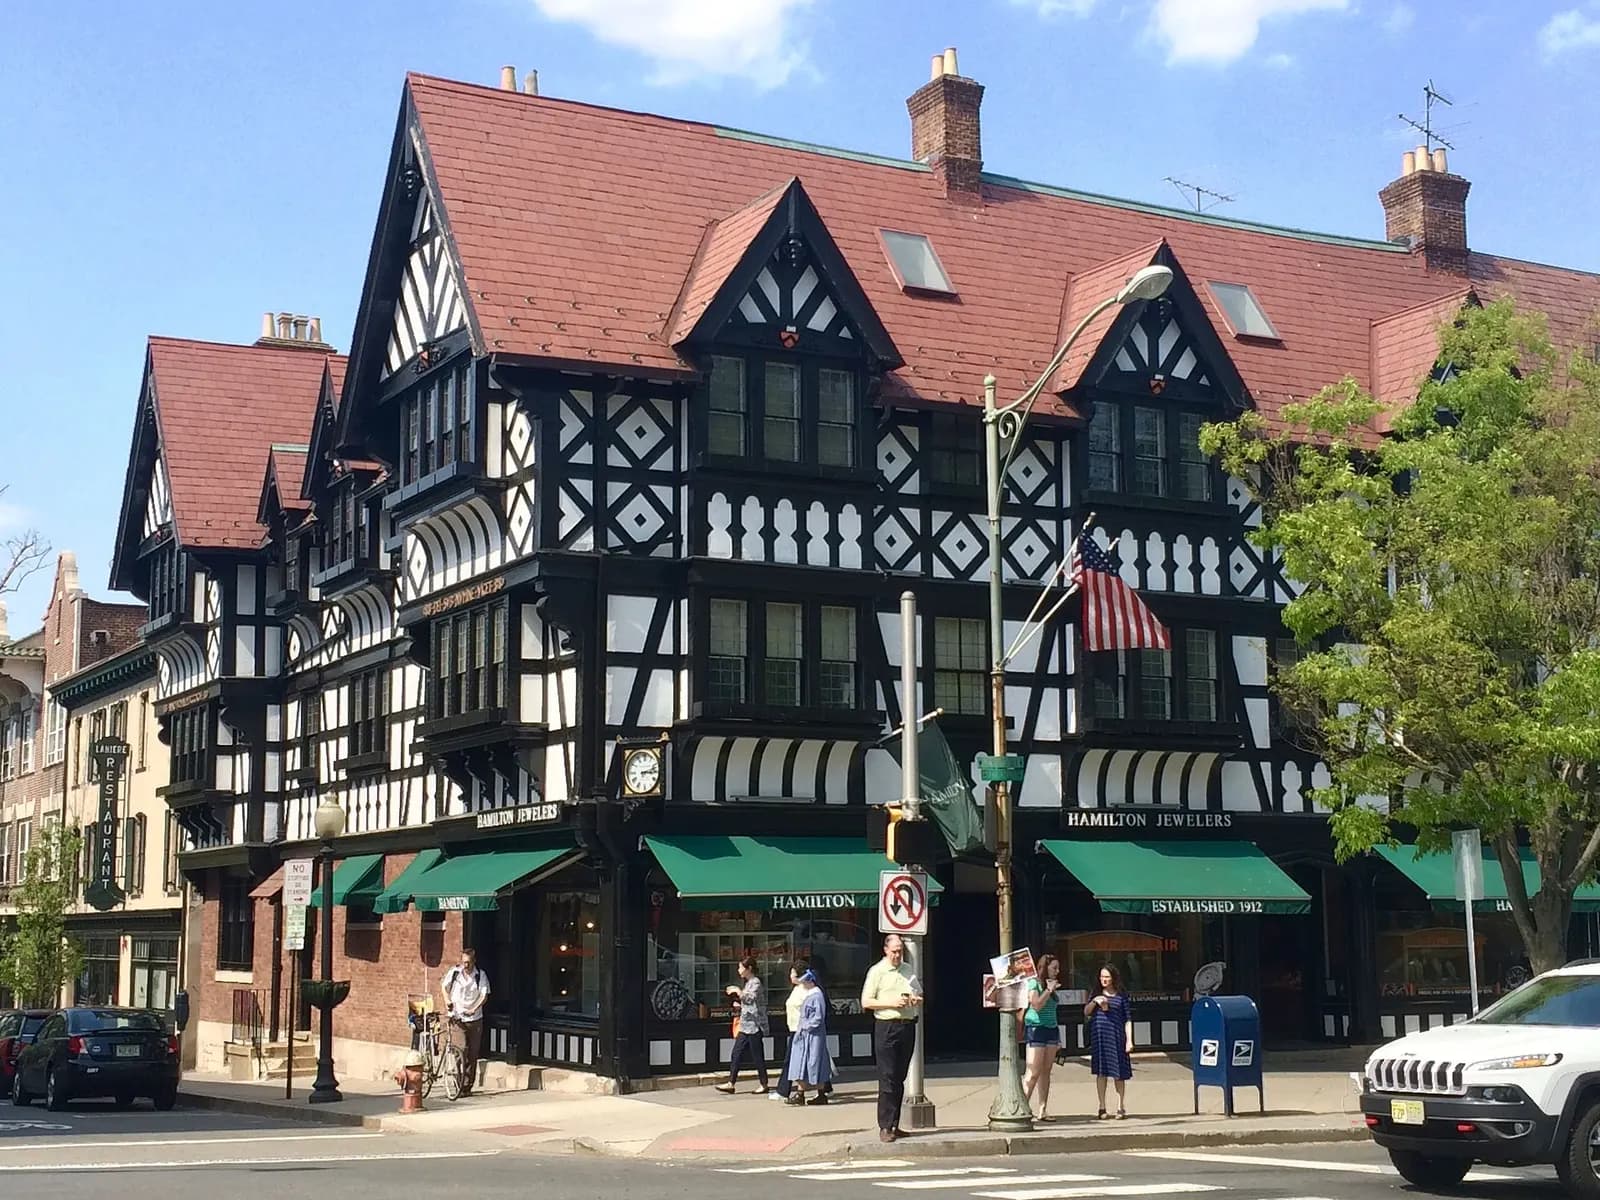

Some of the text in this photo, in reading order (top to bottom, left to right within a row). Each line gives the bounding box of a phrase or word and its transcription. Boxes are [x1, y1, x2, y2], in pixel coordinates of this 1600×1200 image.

[101, 756, 115, 890] RESTAURANT
[477, 803, 558, 829] HAMILTON JEWELERS
[1067, 812, 1232, 828] HAMILTON JEWELERS
[292, 864, 305, 873] NO
[437, 896, 470, 910] HAMILTON
[772, 894, 856, 909] HAMILTON
[1152, 900, 1263, 913] ESTABLISHED 1912
